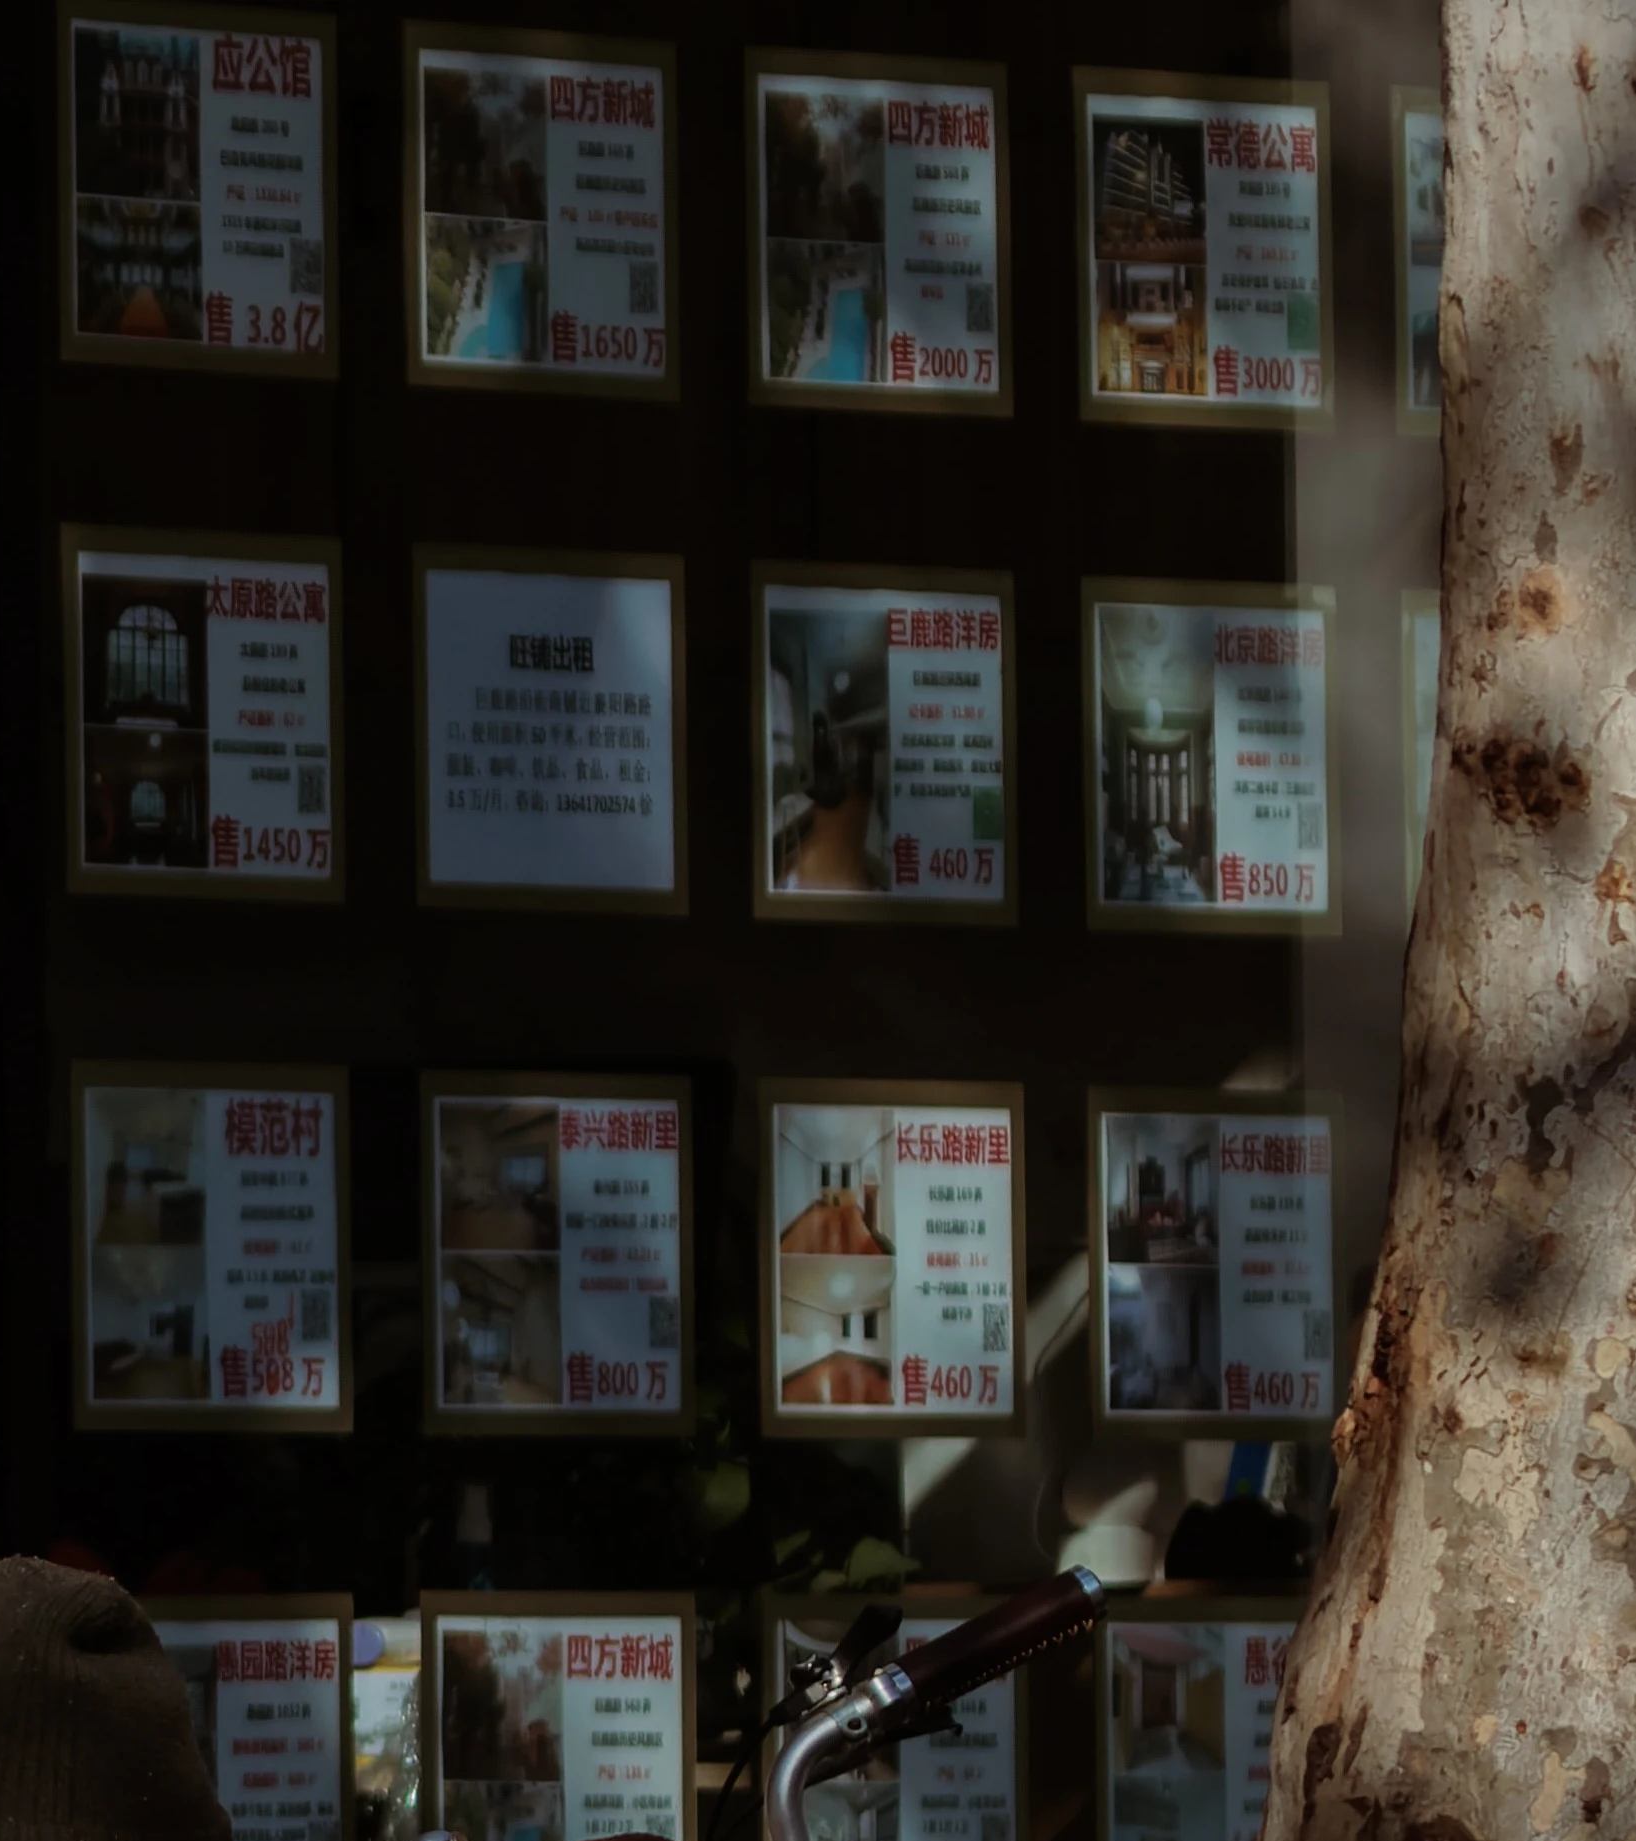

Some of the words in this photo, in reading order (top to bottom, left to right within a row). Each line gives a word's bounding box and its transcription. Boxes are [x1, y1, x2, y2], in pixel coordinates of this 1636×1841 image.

[211, 32, 312, 99] 应公馆
[550, 76, 655, 129] 四方新城
[888, 100, 990, 150] 四方新城
[1207, 118, 1316, 173] 常德公寓
[204, 291, 232, 346] 售
[246, 304, 287, 346] 3.8
[294, 300, 324, 353] 亿
[207, 575, 326, 624] 太原路公寓
[509, 634, 595, 673] 旺铺出租
[887, 608, 1000, 651] 巨鹿路洋房
[1213, 624, 1323, 668] 北京路洋房
[893, 833, 920, 886] 售
[929, 848, 969, 881] 460
[974, 847, 995, 885] 万
[225, 1097, 323, 1159] 模范村
[560, 1109, 677, 1151] 泰兴路新里
[896, 1122, 1010, 1166] 长乐路新里
[1220, 1133, 1329, 1176] 长乐路新里
[217, 1637, 337, 1682] 愚园路洋房
[566, 1633, 675, 1681] 四方新城
